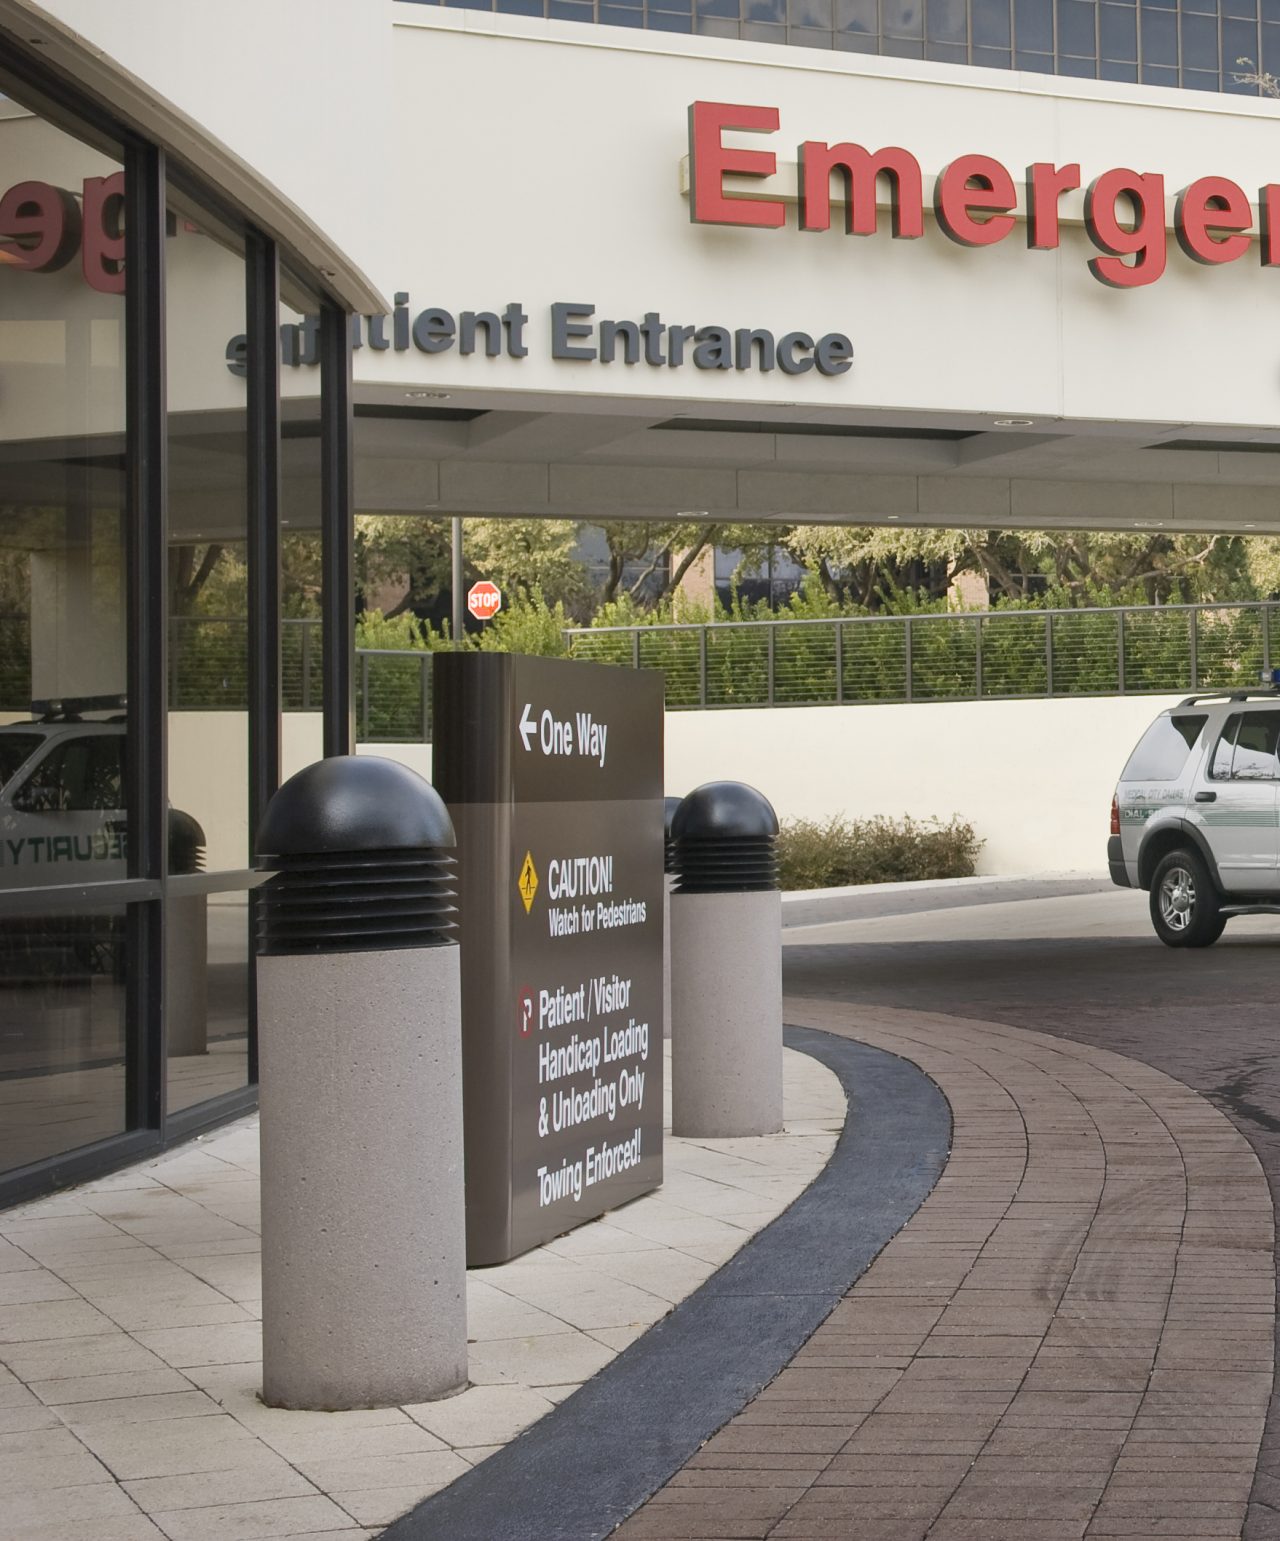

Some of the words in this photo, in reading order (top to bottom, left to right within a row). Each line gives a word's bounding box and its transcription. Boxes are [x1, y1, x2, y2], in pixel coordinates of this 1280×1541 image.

[551, 302, 854, 376] Entrance
[470, 592, 498, 608] STOP
[540, 709, 573, 755] One
[576, 712, 607, 768] Way
[548, 856, 613, 900] CAUTION!
[548, 905, 579, 937] Watch
[582, 904, 594, 932] for
[597, 898, 646, 929] Pedestrians
[539, 983, 585, 1030] Patient
[539, 1034, 600, 1084] Handicap
[603, 1018, 649, 1061] Loading
[538, 1096, 549, 1138] &
[553, 1079, 616, 1132] Unloading
[619, 1065, 645, 1110] Only
[537, 1158, 582, 1207] Towing
[586, 1128, 641, 1187] Enforced!
